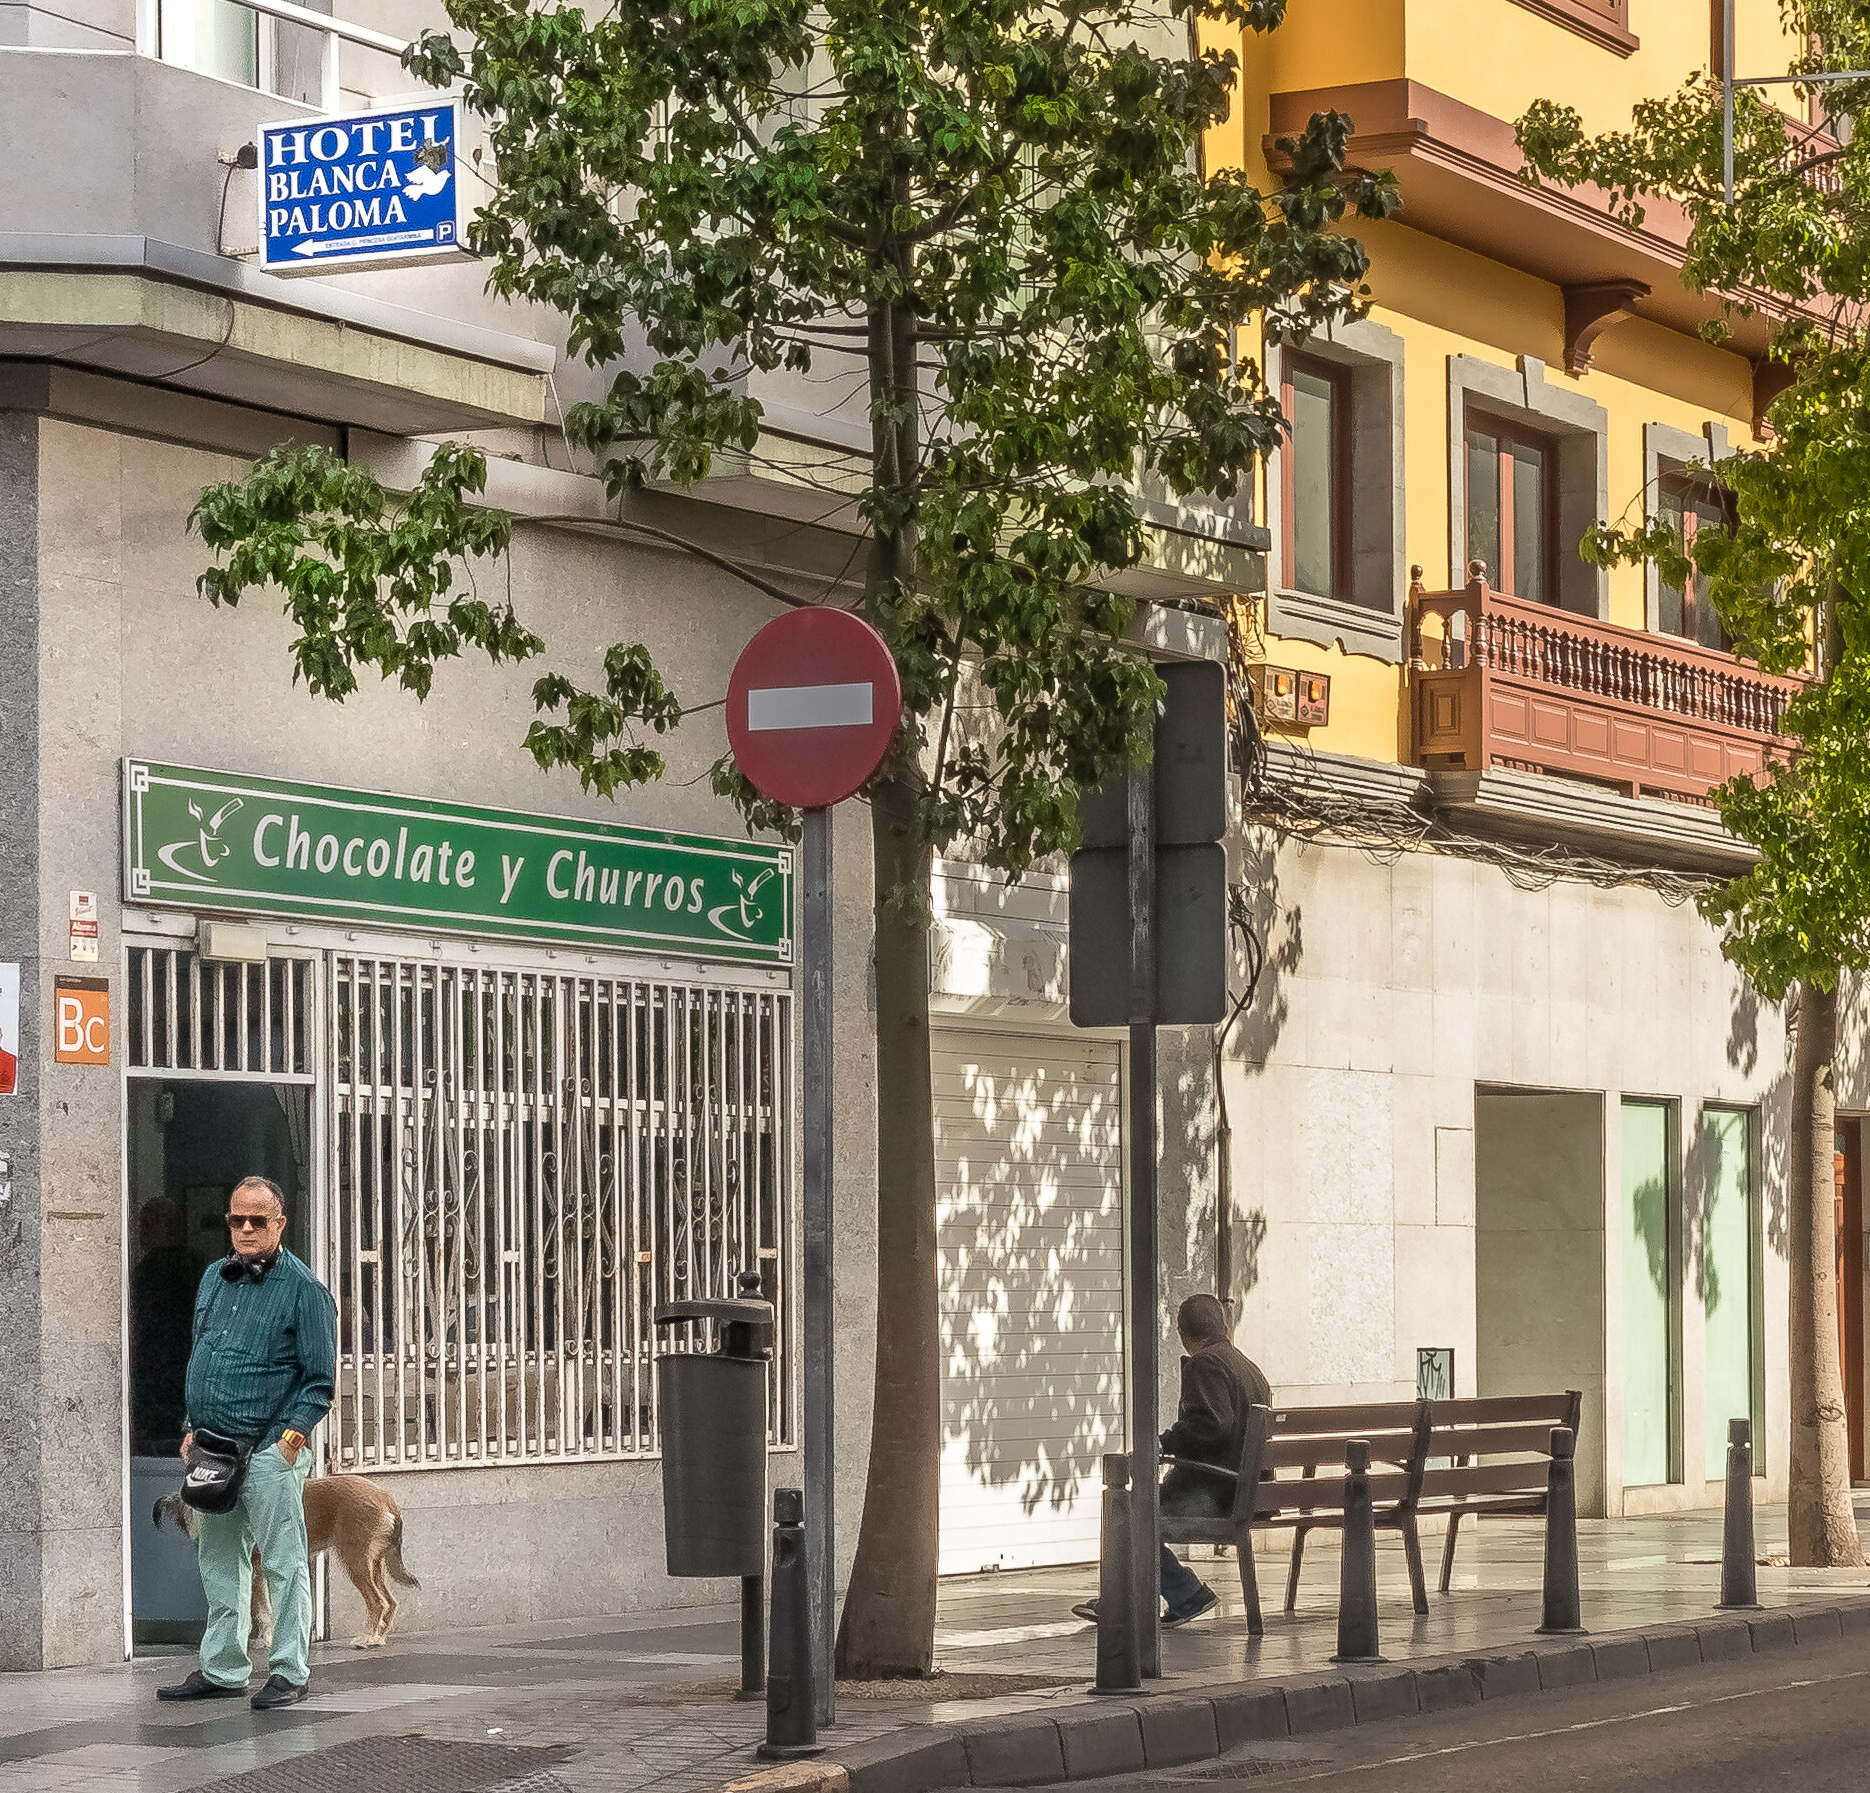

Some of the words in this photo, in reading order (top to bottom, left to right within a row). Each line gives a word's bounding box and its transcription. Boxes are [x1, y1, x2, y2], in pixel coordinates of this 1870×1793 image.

[268, 115, 450, 167] HOTEL
[268, 159, 402, 202] BLANCA
[268, 195, 408, 237] PALOMA
[252, 813, 476, 888] Chocolate
[500, 854, 525, 905] y
[546, 849, 706, 914] Churros
[58, 996, 105, 1055] Bc
[191, 1466, 220, 1482] NIKE
